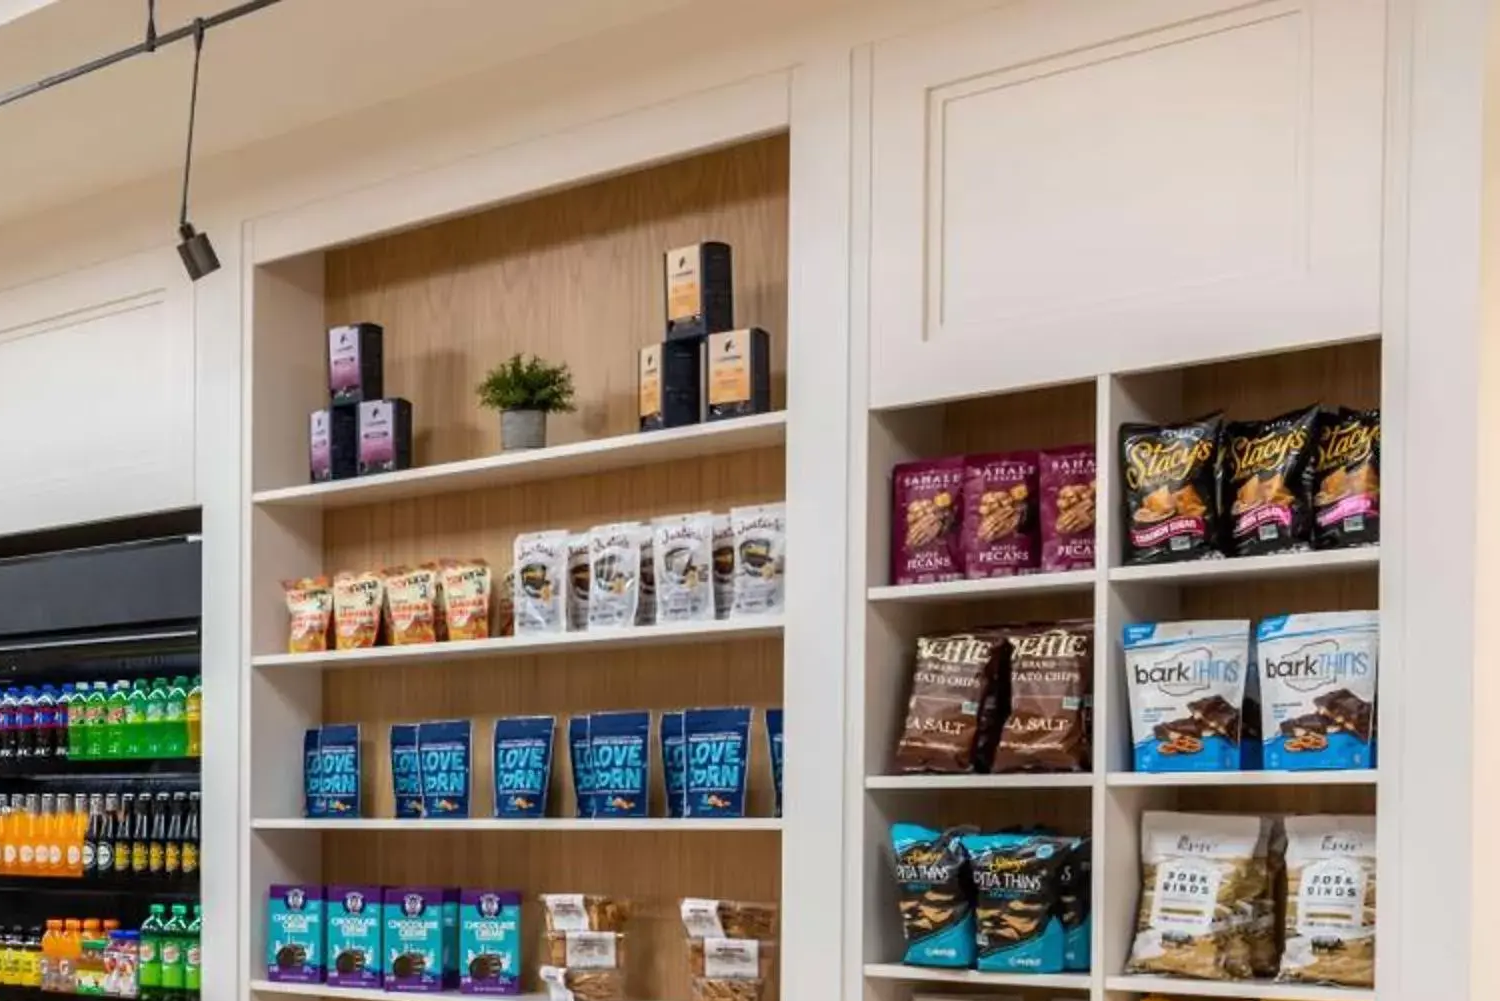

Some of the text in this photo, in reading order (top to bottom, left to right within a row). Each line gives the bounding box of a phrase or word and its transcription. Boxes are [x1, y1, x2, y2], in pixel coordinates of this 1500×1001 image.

[1232, 426, 1307, 482] Stacy's
[1126, 439, 1213, 490] Stacy's
[980, 550, 1029, 563] PECANS
[947, 677, 981, 688] CHIPS
[1045, 671, 1081, 683] CHIPS
[924, 717, 965, 736] SALT
[1027, 717, 1070, 732] SALT
[918, 865, 951, 881] THINS
[973, 871, 1042, 891] PITA THINS
